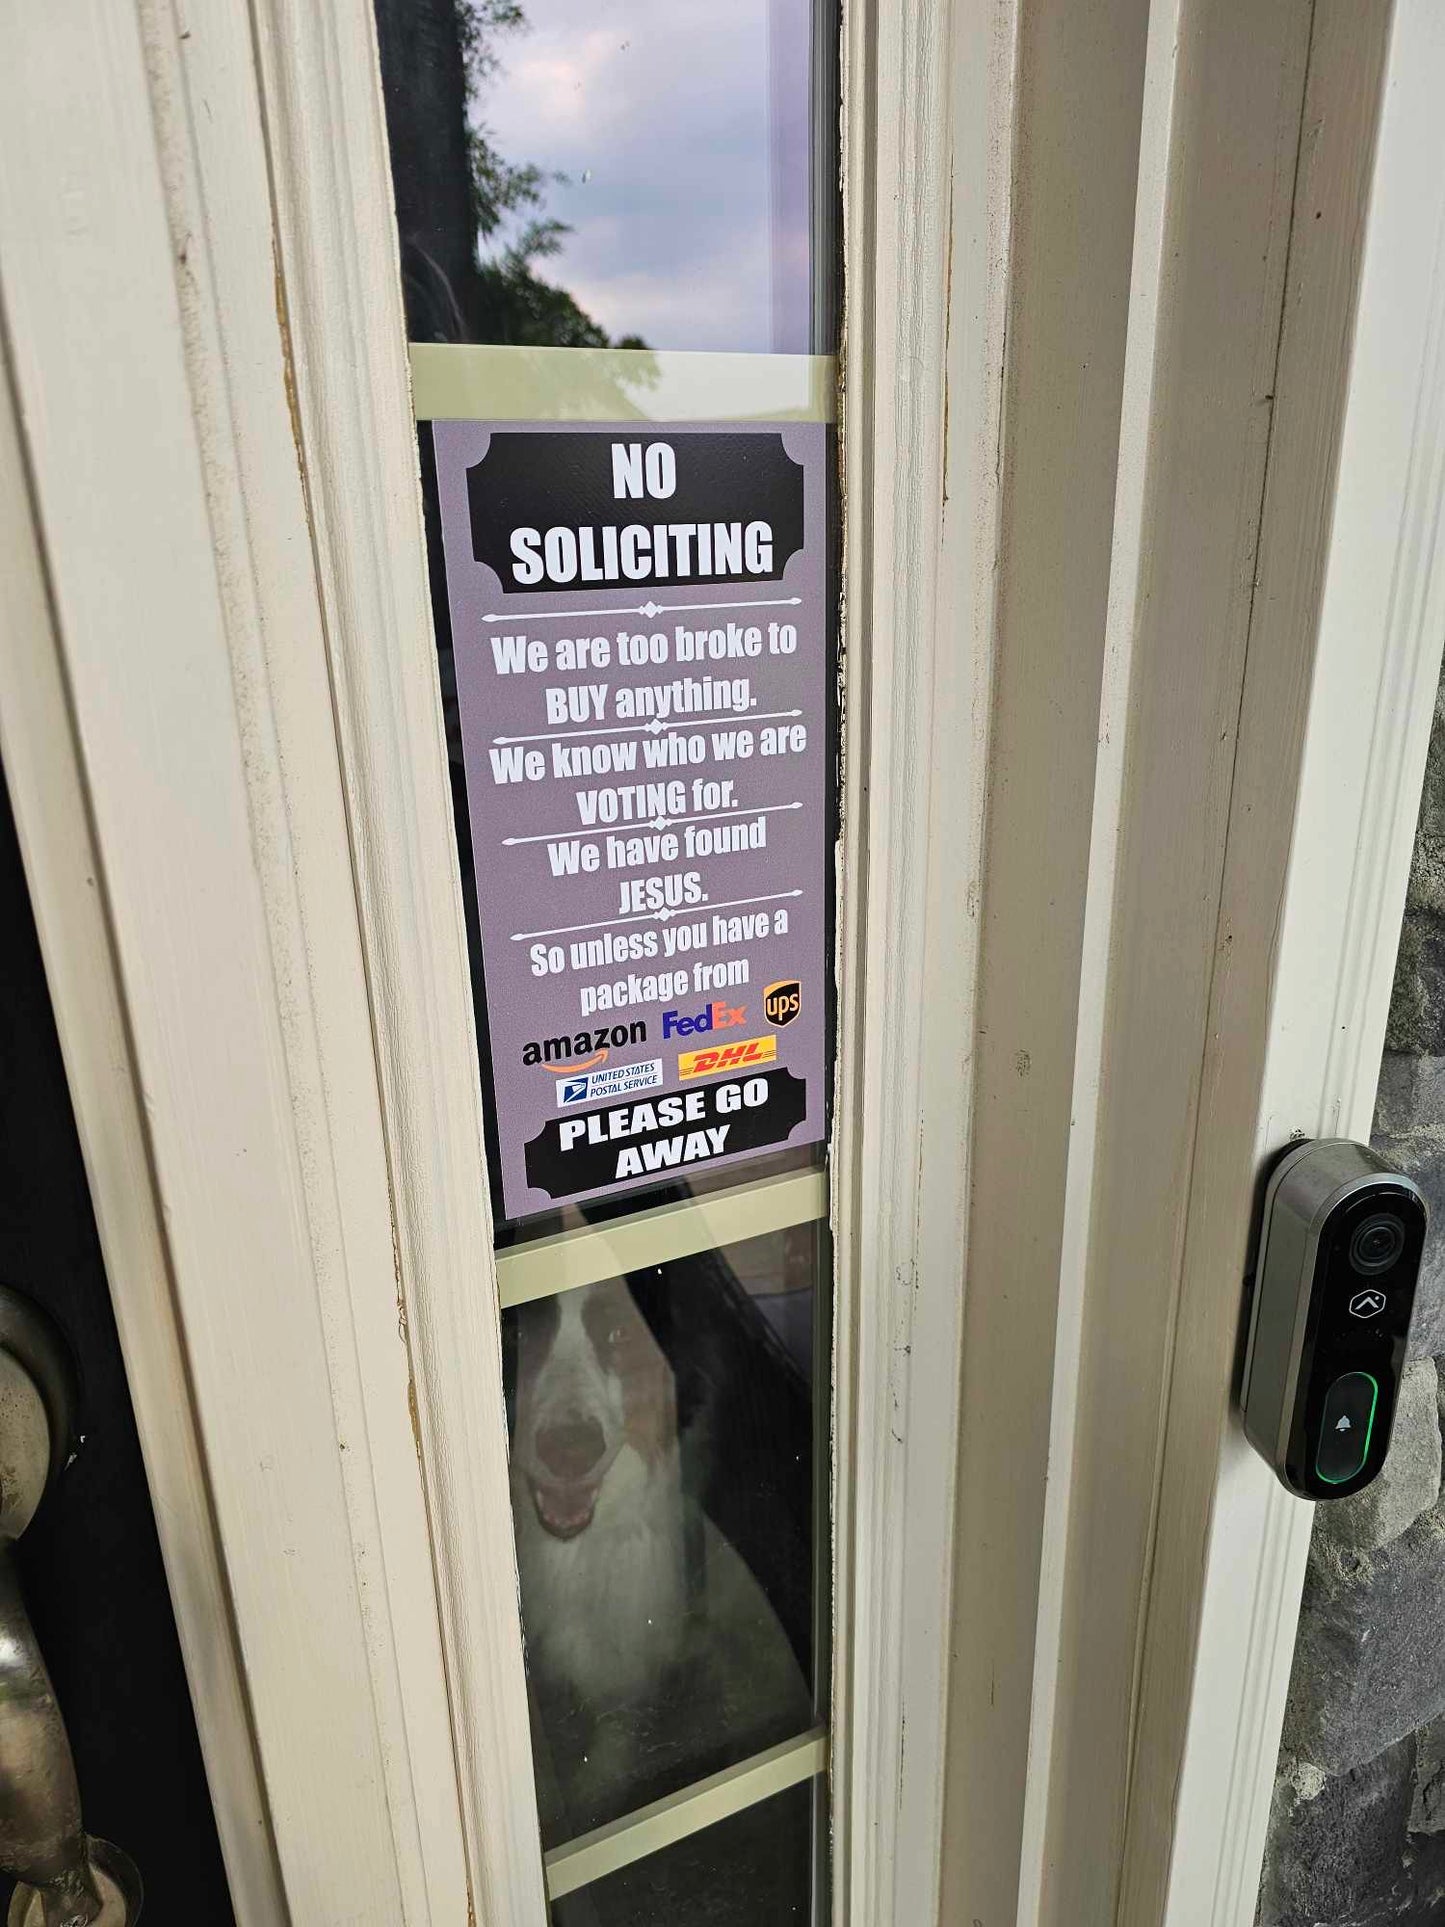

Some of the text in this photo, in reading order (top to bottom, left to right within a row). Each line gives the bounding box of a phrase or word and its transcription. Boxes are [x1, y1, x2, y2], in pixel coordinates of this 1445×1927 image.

[611, 442, 676, 499] NO
[510, 521, 773, 584] SOLICITING
[491, 622, 797, 674] We are too broke to
[546, 676, 757, 725] BUY anything.
[489, 724, 807, 784] We know who we are
[576, 778, 738, 825] VOTING for.
[547, 816, 767, 876] We have found
[619, 871, 708, 914] JESUS.
[530, 909, 789, 977] So unless you have a
[580, 958, 750, 1017] package from
[765, 992, 800, 1020] ups
[522, 1020, 647, 1066] amazon
[662, 1001, 748, 1040] FedEx
[591, 1062, 655, 1084] UNITED STATES
[692, 1041, 766, 1074] DHL
[590, 1074, 658, 1098] POSTAL SERVICE
[559, 1077, 769, 1152] PLEASE GO
[615, 1124, 731, 1179] AWAY
